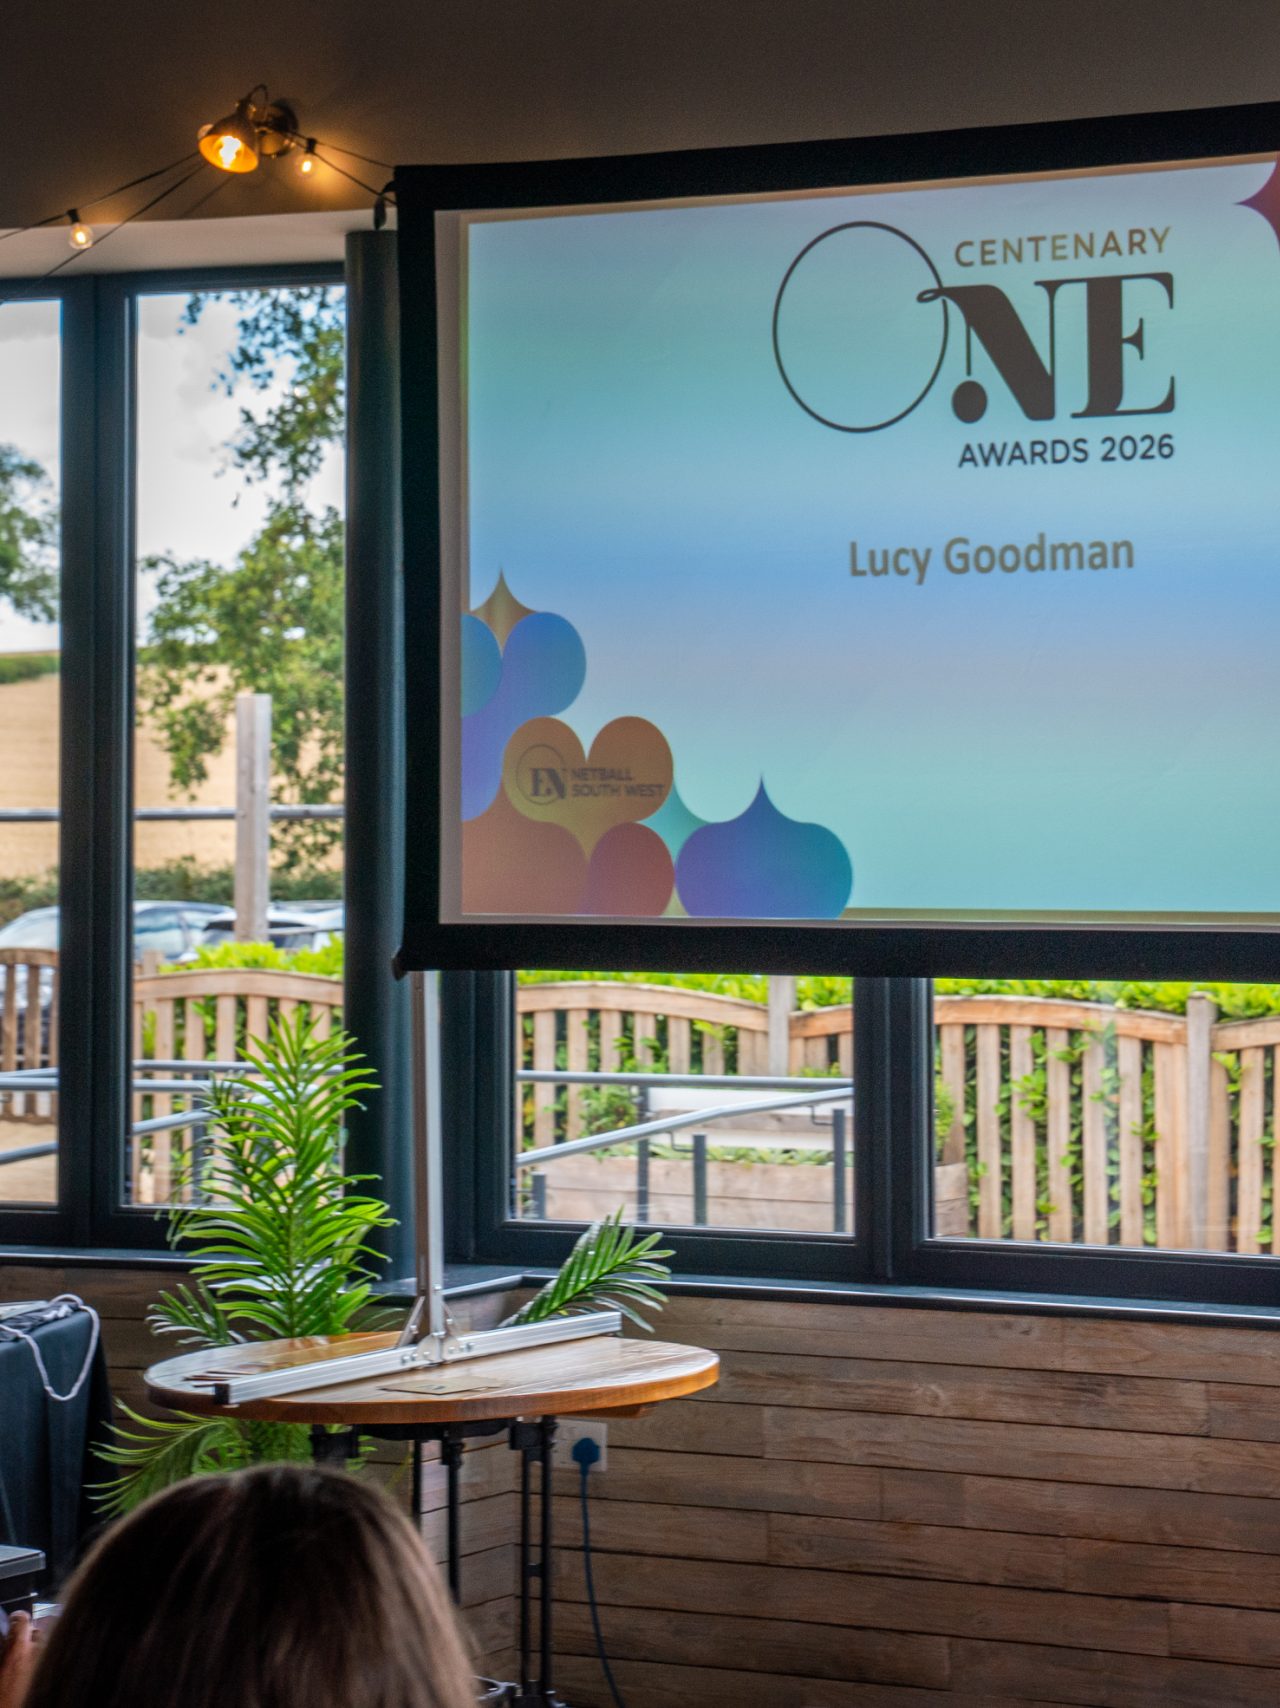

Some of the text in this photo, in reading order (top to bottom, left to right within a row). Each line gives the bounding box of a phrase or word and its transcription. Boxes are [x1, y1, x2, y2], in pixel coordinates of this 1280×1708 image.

[954, 226, 1172, 267] CENTENARY
[772, 220, 1176, 434] ONE
[957, 434, 1175, 468] AWARDS 2026
[849, 533, 1135, 585] Lucy Goodman
[571, 767, 633, 781] NETBALL
[571, 784, 666, 798] SOUTH WEST
